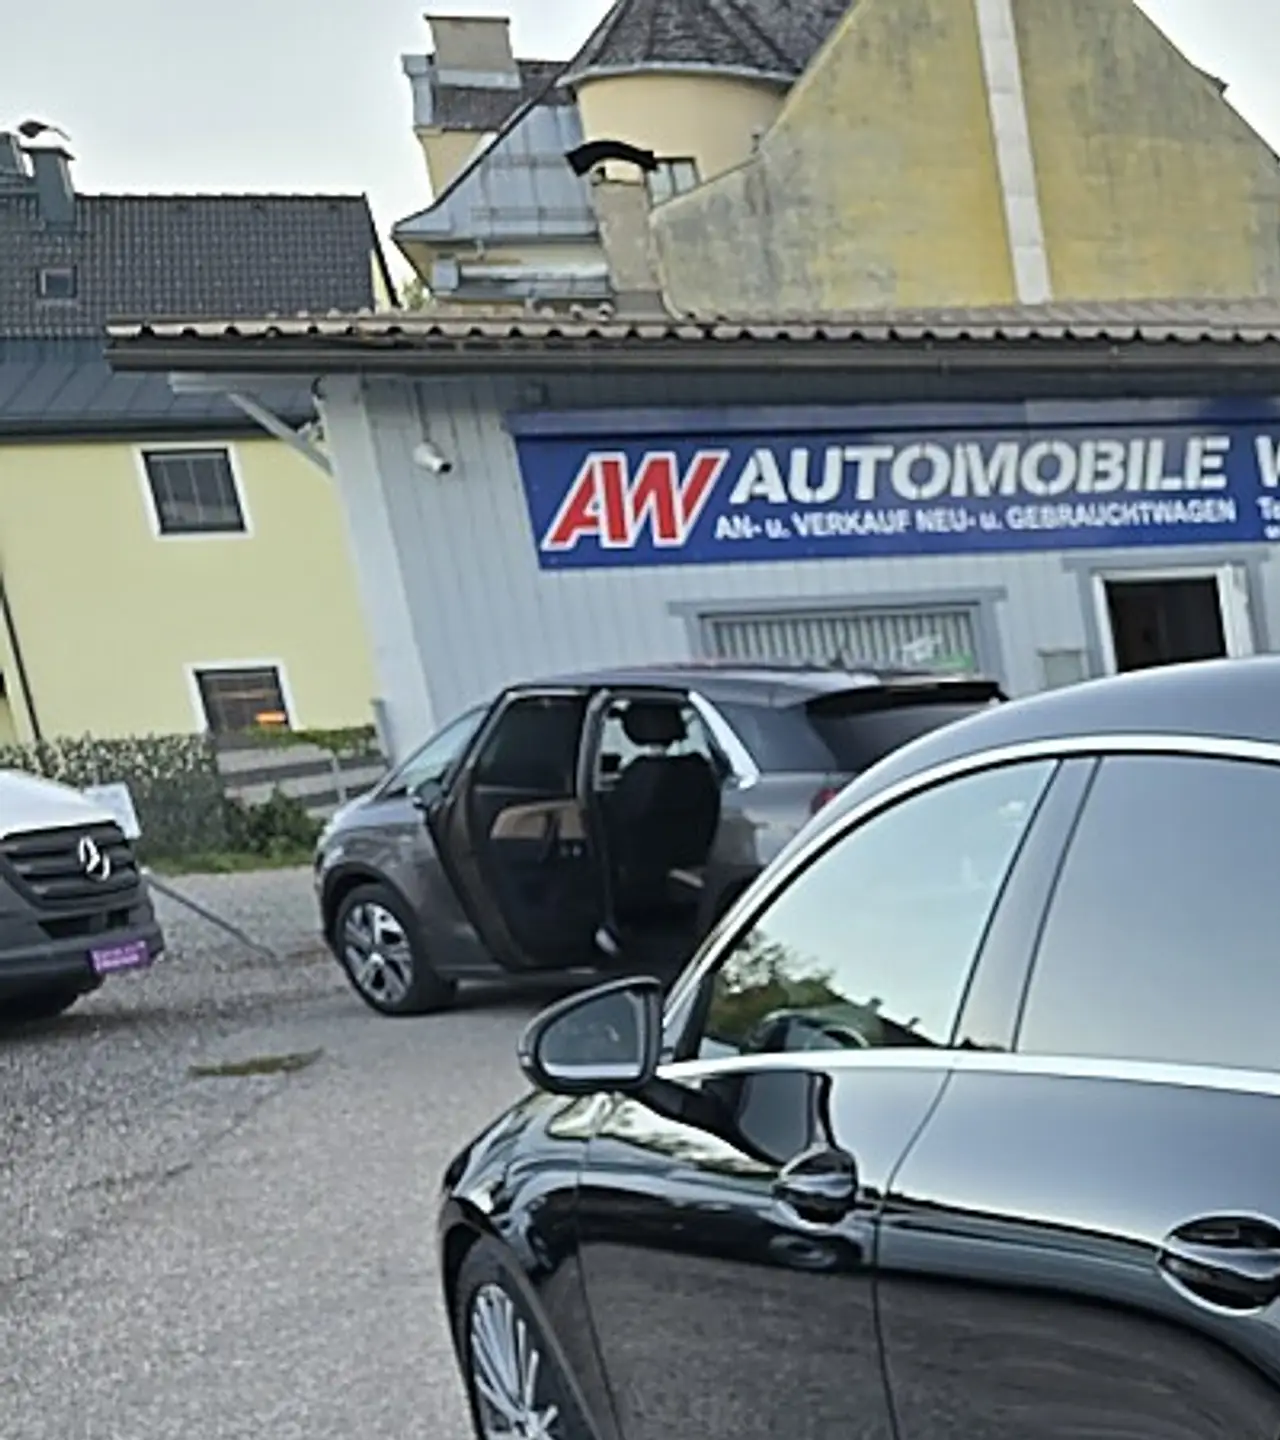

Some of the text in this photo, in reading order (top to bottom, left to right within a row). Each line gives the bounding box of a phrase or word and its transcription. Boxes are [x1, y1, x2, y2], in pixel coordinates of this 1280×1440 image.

[541, 450, 729, 551] AW
[729, 435, 1230, 505] AUTOMOBILE
[791, 508, 911, 537] VERKAUF
[915, 506, 976, 533] NEU-
[1005, 497, 1236, 530] GEBRAUCHTWAGEN
